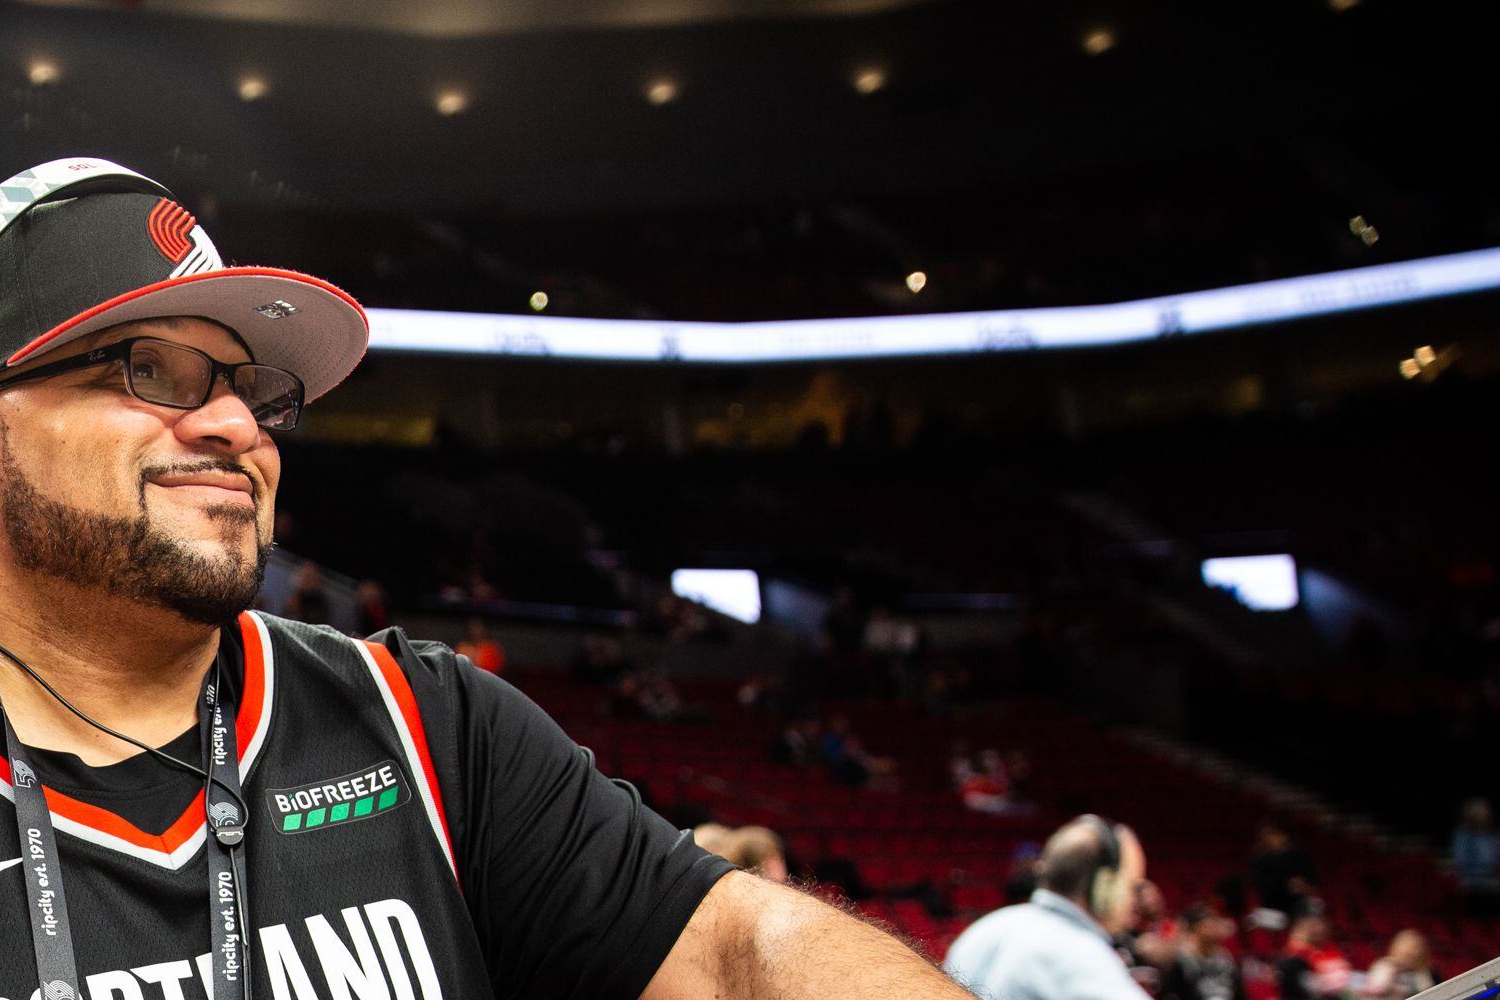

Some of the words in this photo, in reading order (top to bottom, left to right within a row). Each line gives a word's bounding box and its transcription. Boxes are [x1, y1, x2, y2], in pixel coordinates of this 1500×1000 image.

[27, 828, 45, 863] 1970
[35, 862, 51, 889] est.
[218, 871, 234, 904] 1970
[37, 889, 57, 936] ripcity
[220, 905, 235, 932] est.
[221, 932, 240, 981] ripcity
